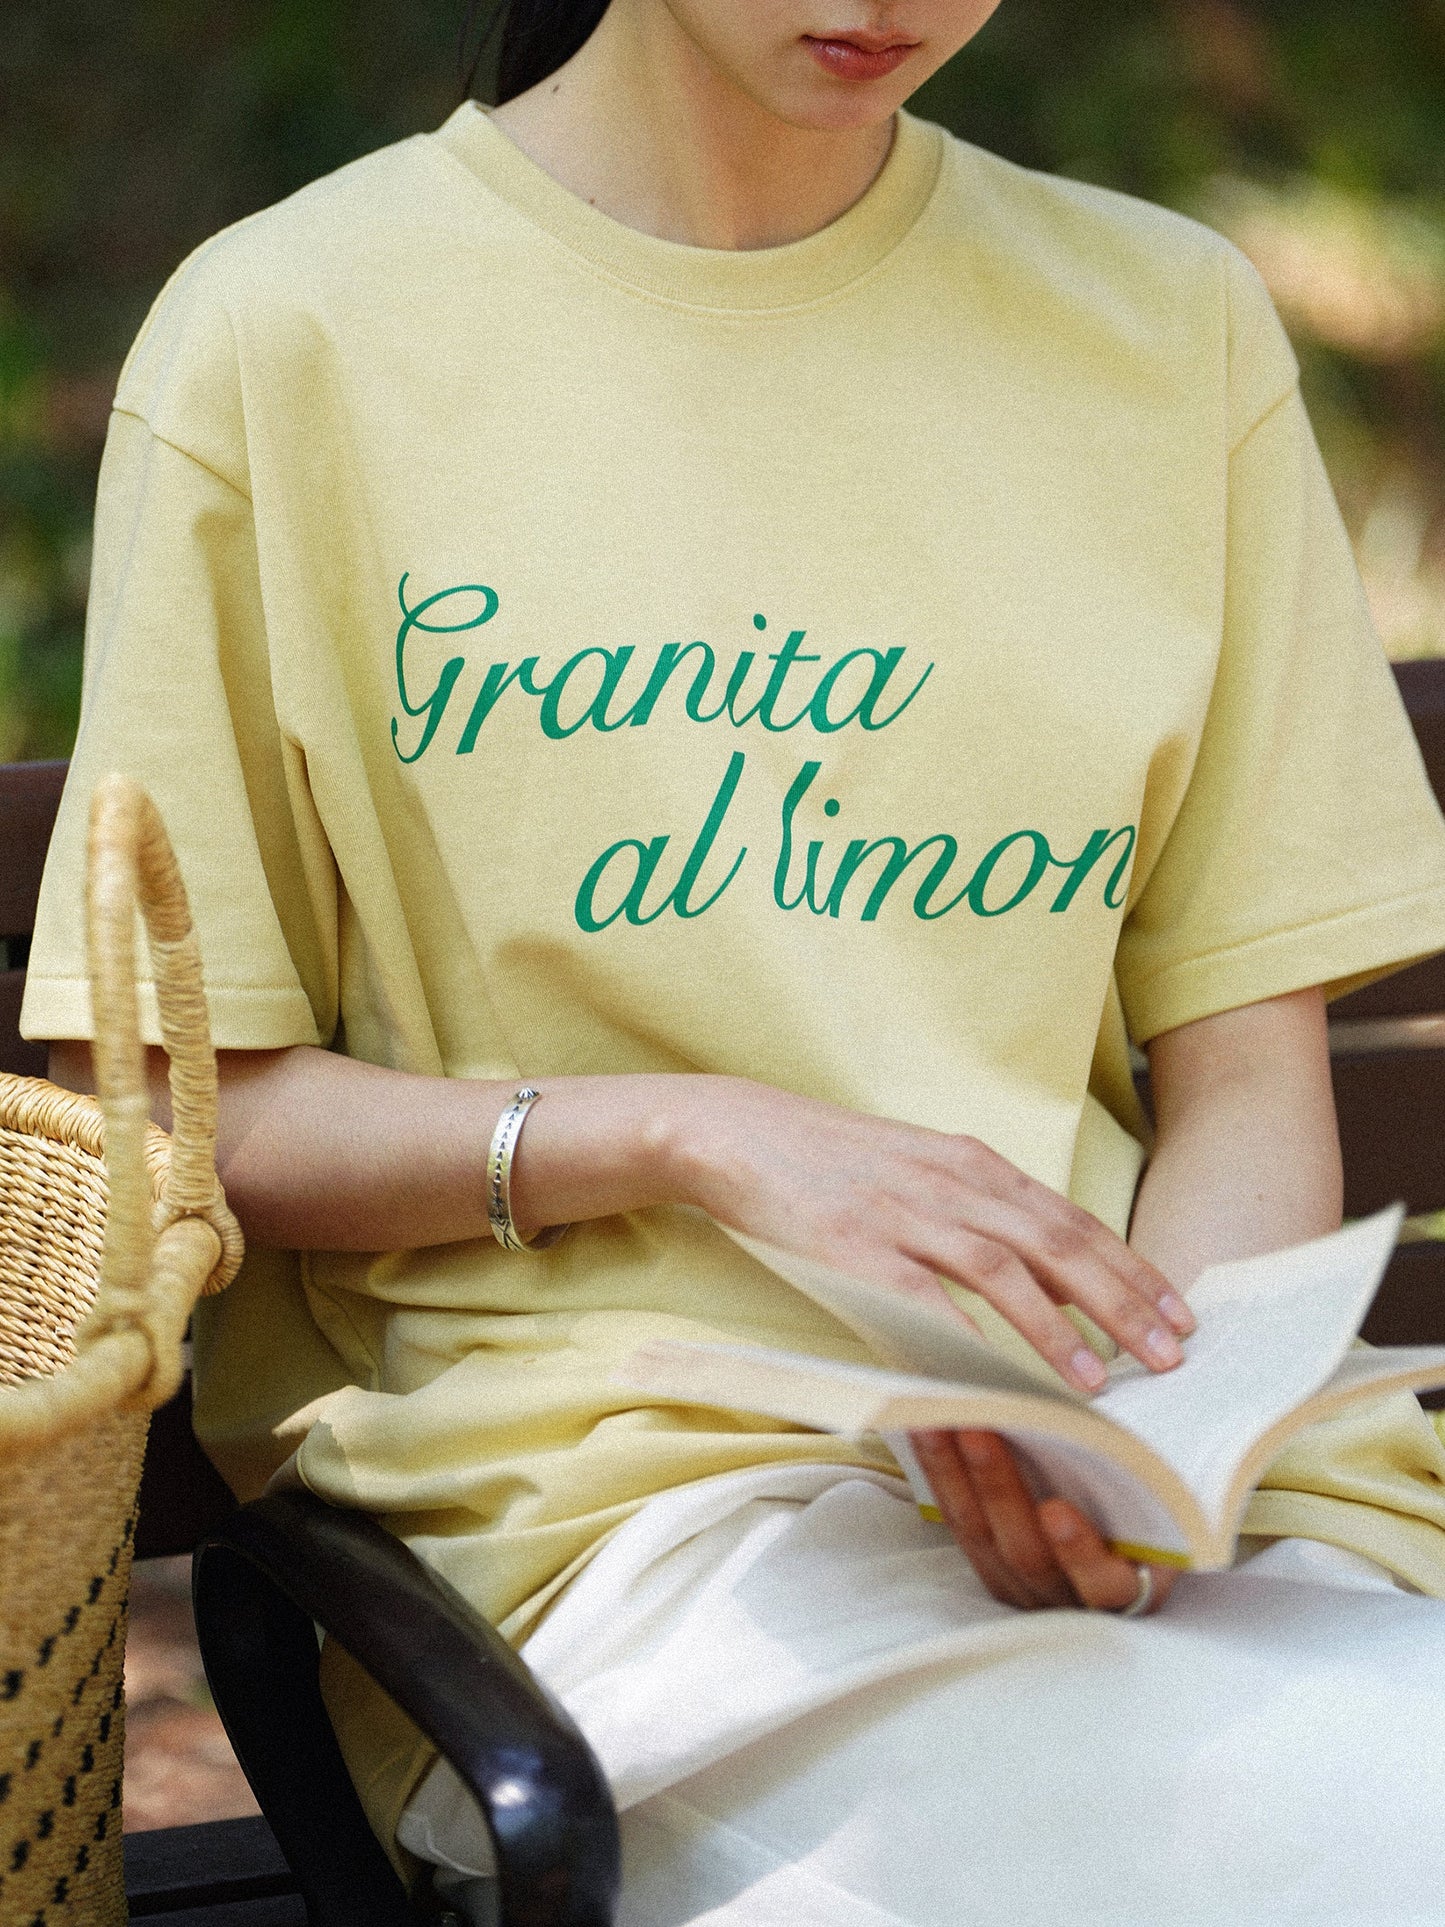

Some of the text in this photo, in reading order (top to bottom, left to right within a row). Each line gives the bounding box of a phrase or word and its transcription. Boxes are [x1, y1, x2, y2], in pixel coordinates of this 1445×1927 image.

[391, 572, 934, 764] Granita
[574, 751, 1136, 933] al limon
